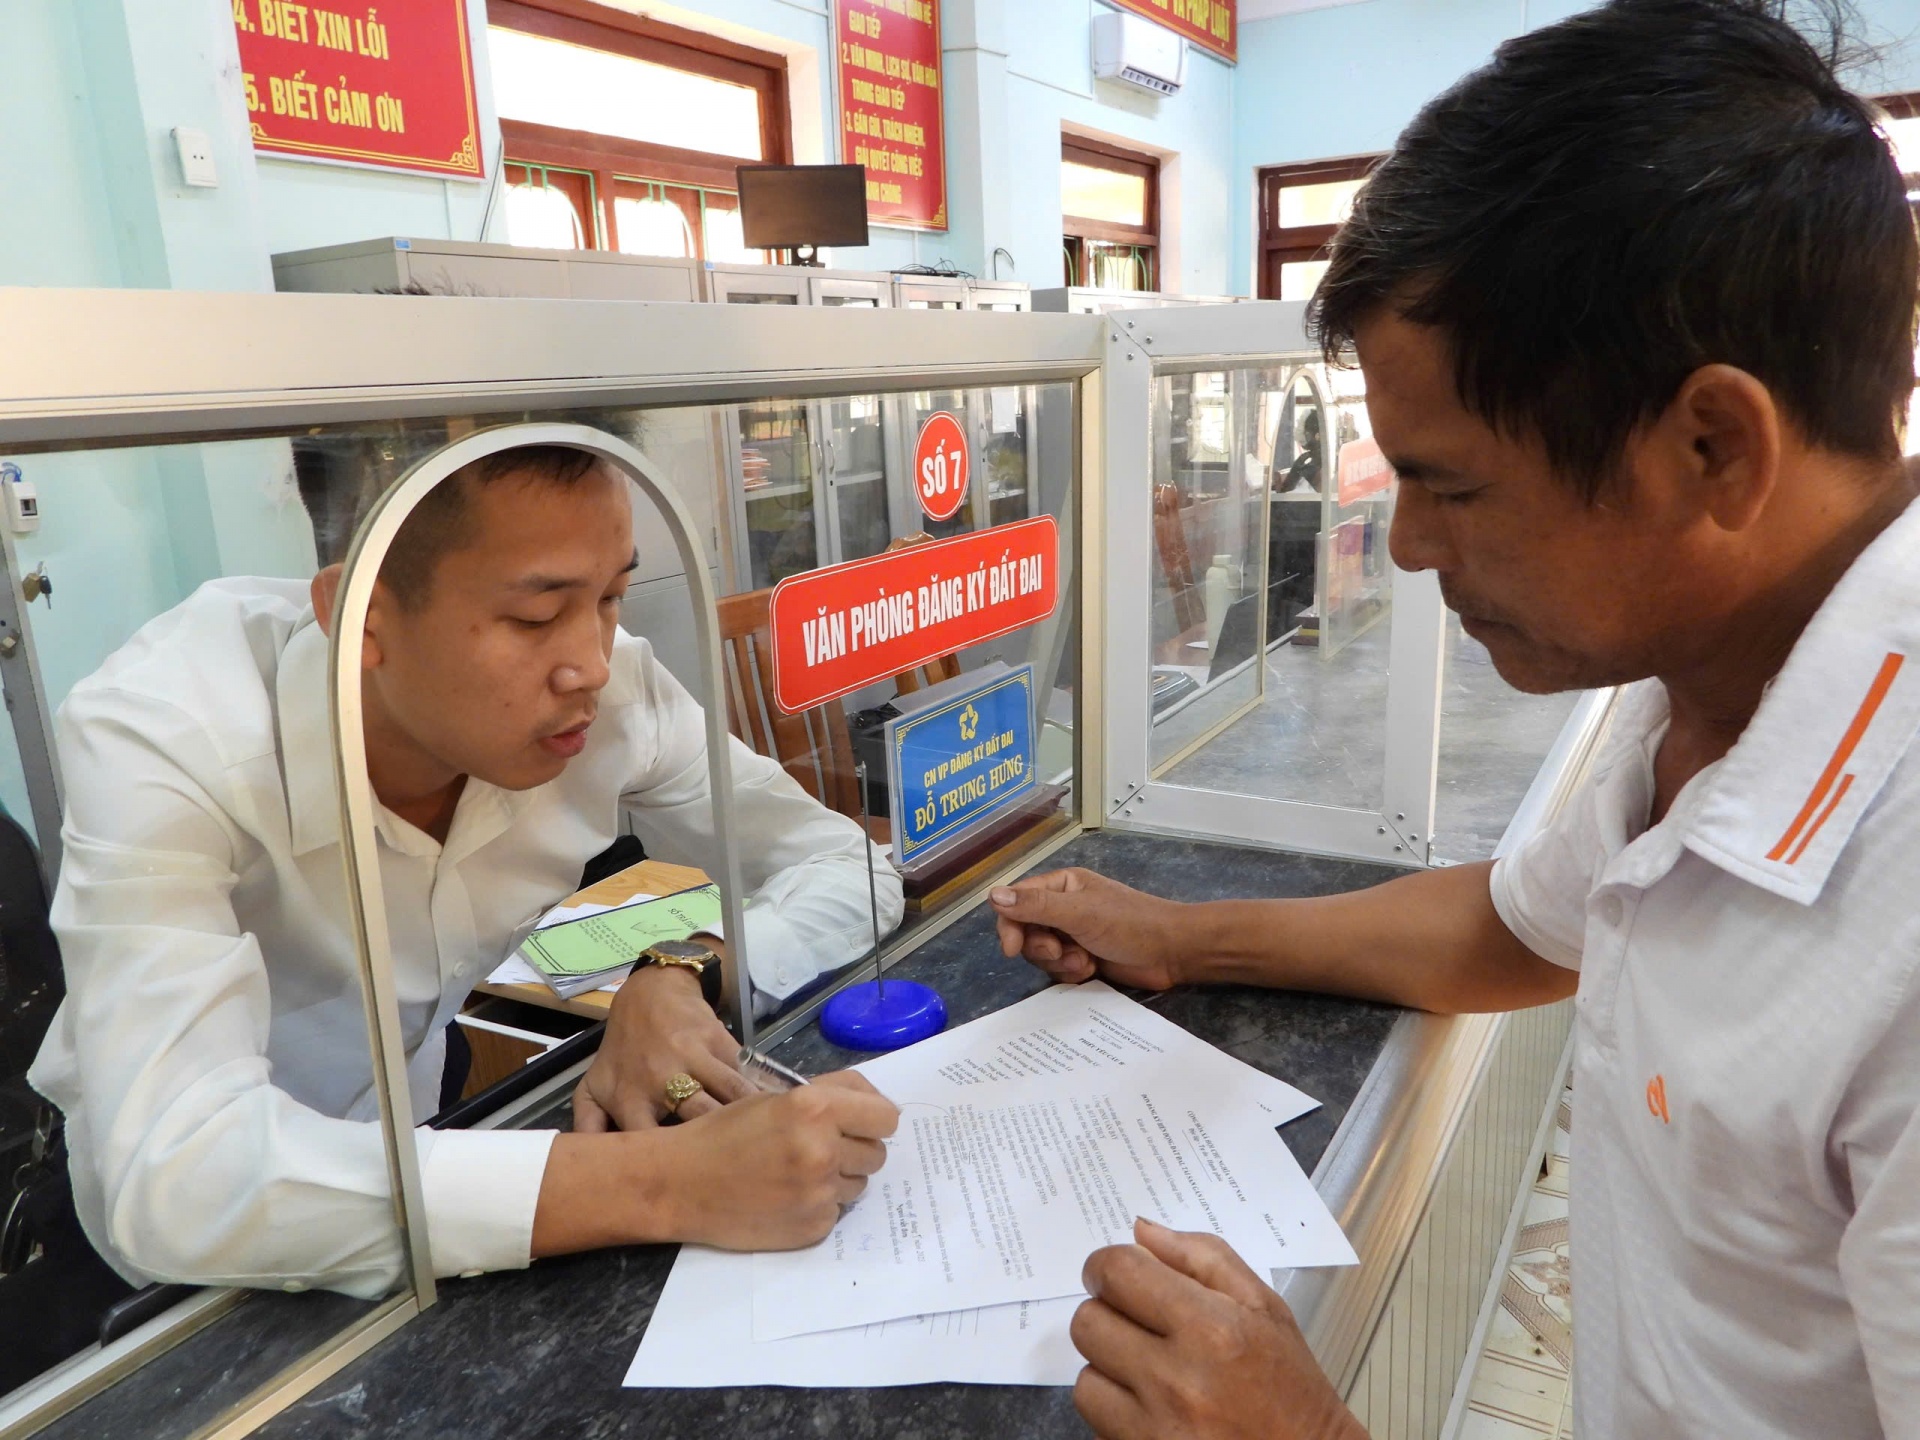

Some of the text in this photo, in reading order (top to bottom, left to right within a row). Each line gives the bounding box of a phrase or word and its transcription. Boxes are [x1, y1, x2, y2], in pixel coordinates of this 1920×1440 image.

[313, 9, 354, 52] XIN
[355, 7, 390, 60] LỖI
[866, 12, 882, 39] TIẾP
[842, 42, 850, 64] 2.
[850, 41, 865, 68] VĂN
[911, 60, 925, 85] VĂN
[242, 70, 405, 134] 5. BIẾT CẢM ƠN
[852, 78, 905, 110] TRONG GIAO TIẾP
[846, 110, 853, 132] 3.
[882, 116, 903, 142] TRÁCH
[869, 144, 890, 171] QUYẾT
[890, 149, 908, 175] CÔNG
[908, 153, 923, 180] VIỆC
[880, 180, 902, 204] CHÓNG
[922, 439, 962, 498] SỐ 7
[802, 548, 1042, 668] VĂN PHÒNG ĐĂNG KÝ ĐẤT ĐAI
[924, 729, 1014, 788] CN VP ĐĂNG KÝ ĐẤT ĐAI
[914, 754, 1024, 832] ĐỖ TRUNG HƯNG
